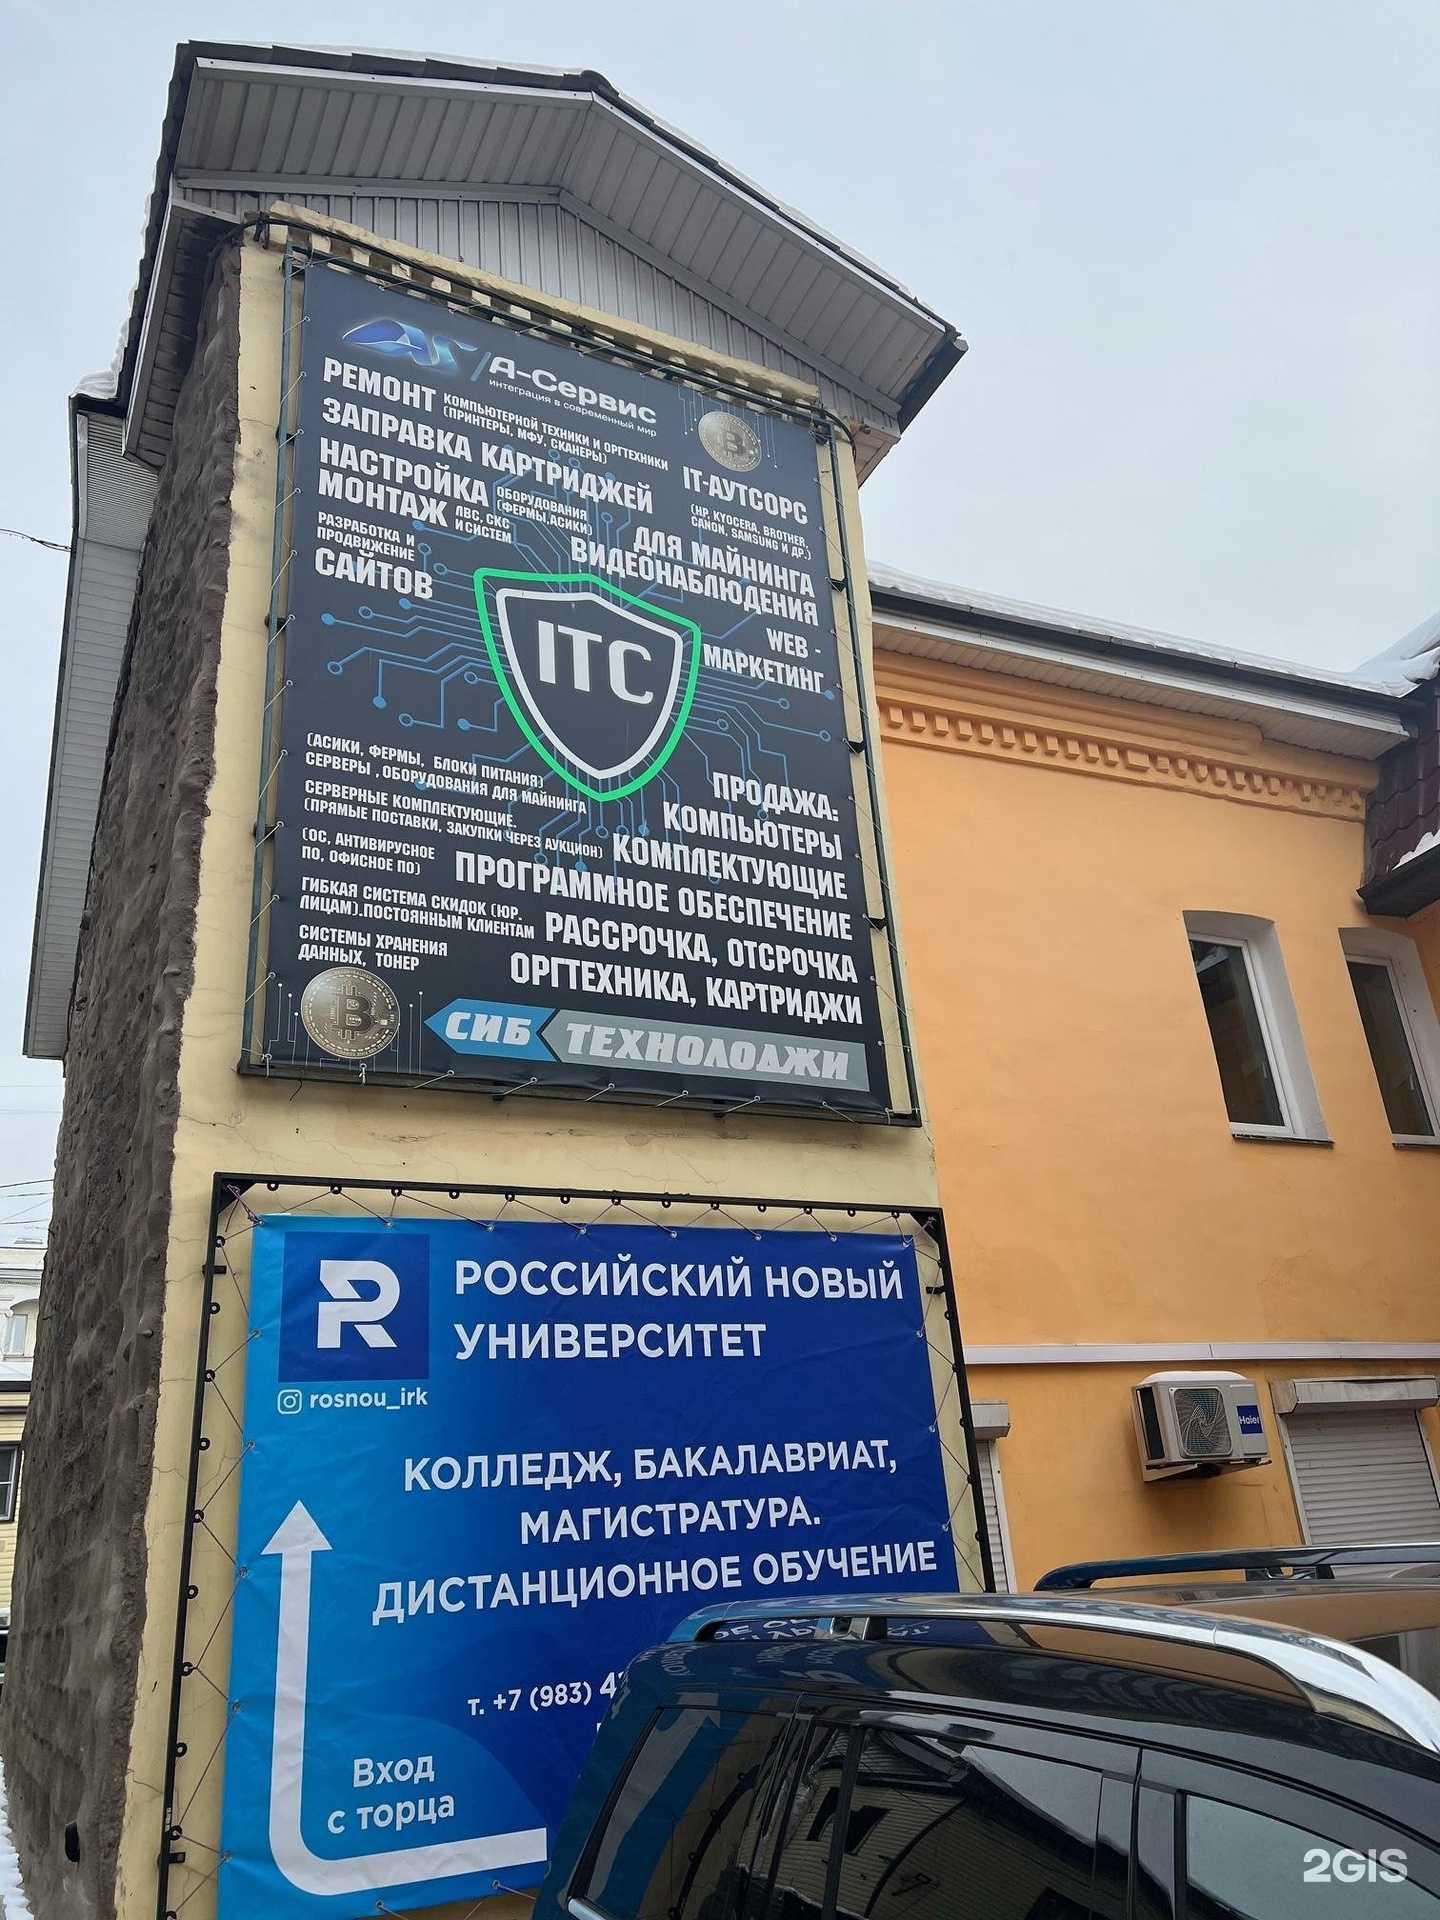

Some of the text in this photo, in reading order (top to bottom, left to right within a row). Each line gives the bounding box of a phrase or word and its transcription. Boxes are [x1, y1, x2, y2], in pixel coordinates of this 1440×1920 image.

[323, 357, 437, 412] РЕМОНТ
[488, 379, 657, 438] интеграция в современный мир
[489, 356, 657, 425] А-Сервис
[321, 397, 473, 462] ЗАПРАВКА
[480, 441, 654, 514] КАРТРИДЖЕЙ
[443, 392, 538, 430] КОМПЬЮТЕРНОЙ
[541, 423, 590, 447] ТЕХНИКИ
[593, 436, 601, 450] И
[603, 440, 669, 471] ОРГТЕХНИКИ
[320, 437, 490, 507] НАСТРОЙКА
[682, 466, 808, 525] IT-АУТСОРС
[318, 468, 449, 527] МОНТАЖ
[486, 512, 512, 530] СКС
[496, 485, 588, 521] ОБОРУДОВАНИЯ
[316, 526, 415, 562] ПРОДВИЖЕНИЕ
[318, 511, 415, 547] РАЗРАБОТКА И
[731, 528, 779, 551] SAMSUNG
[781, 542, 789, 555] И
[314, 546, 434, 600] САЙТОВ
[570, 535, 820, 627] ВИДЕОНАБЛЮДЕНИЯ
[633, 525, 817, 598] ДЛЯ МАЙНИНГА
[537, 619, 655, 705] ITC
[765, 627, 810, 659] WEB
[702, 646, 825, 694] МАРКЕТИНГ
[304, 779, 388, 807] СЕРВЕРНЫЕ
[432, 755, 478, 777] БЛОКИ
[481, 765, 545, 788] ПИТАНИЯ)
[711, 770, 840, 823] ПРОДАЖА:
[491, 785, 518, 802] ДЛЯ
[520, 789, 588, 815] МАЙНИНГА
[303, 797, 368, 820] (ПРЯМЫЕ
[446, 820, 501, 843] ЗАКУПКИ
[506, 831, 541, 849] ЧЕРЕЗ
[543, 838, 605, 860] АУКЦИОН)
[335, 831, 436, 861] АНТИВИРУСНОЕ
[662, 801, 845, 861] КОМПЬЮТЕРЫ
[328, 849, 394, 872] ОФИСНОЕ
[396, 861, 421, 876] ПО)
[611, 832, 849, 900] КОМПЛЕКТУЮЩИЕ
[301, 876, 359, 899] ГИБКАЯ
[362, 886, 429, 908] СИСТЕМА
[430, 894, 487, 917] СКИДОК
[454, 850, 854, 941] ПРОГРАММНОЕ ОБЕСПЕЧЕНИЕ
[298, 924, 449, 957] СИСТЕМЫ ХРАНЕНИЯ
[466, 916, 537, 940] КЛИЕНТАМ
[545, 911, 859, 984] РАССРОЧКА, ОТСРОЧКА
[297, 943, 421, 971] ДАННЫХ, ТОНЕР
[510, 951, 864, 1025] ОРГТЕХНИКА, КАРТРИДЖИ
[444, 1011, 532, 1046] СИБ
[566, 1022, 850, 1081] ТЕХНОЛОДЖИ
[454, 1252, 905, 1301] РОССИЙСКИЙ НОВЫЙ
[453, 1322, 768, 1361] УНИВЕРСИТЕТ
[309, 1386, 429, 1411] rosnou_irk
[402, 1438, 899, 1493] КОЛЛЕДЖ, БАКАЛАВРИАТ,
[519, 1495, 822, 1545] МАГИСТРАТУРА.
[371, 1539, 939, 1627] ДИСТАНЦИОННОЕ ОБУЧЕНИЕ
[492, 1688, 522, 1712] +7
[529, 1680, 594, 1712] (983)
[352, 1755, 436, 1788] Вход
[327, 1794, 455, 1835] с торца
